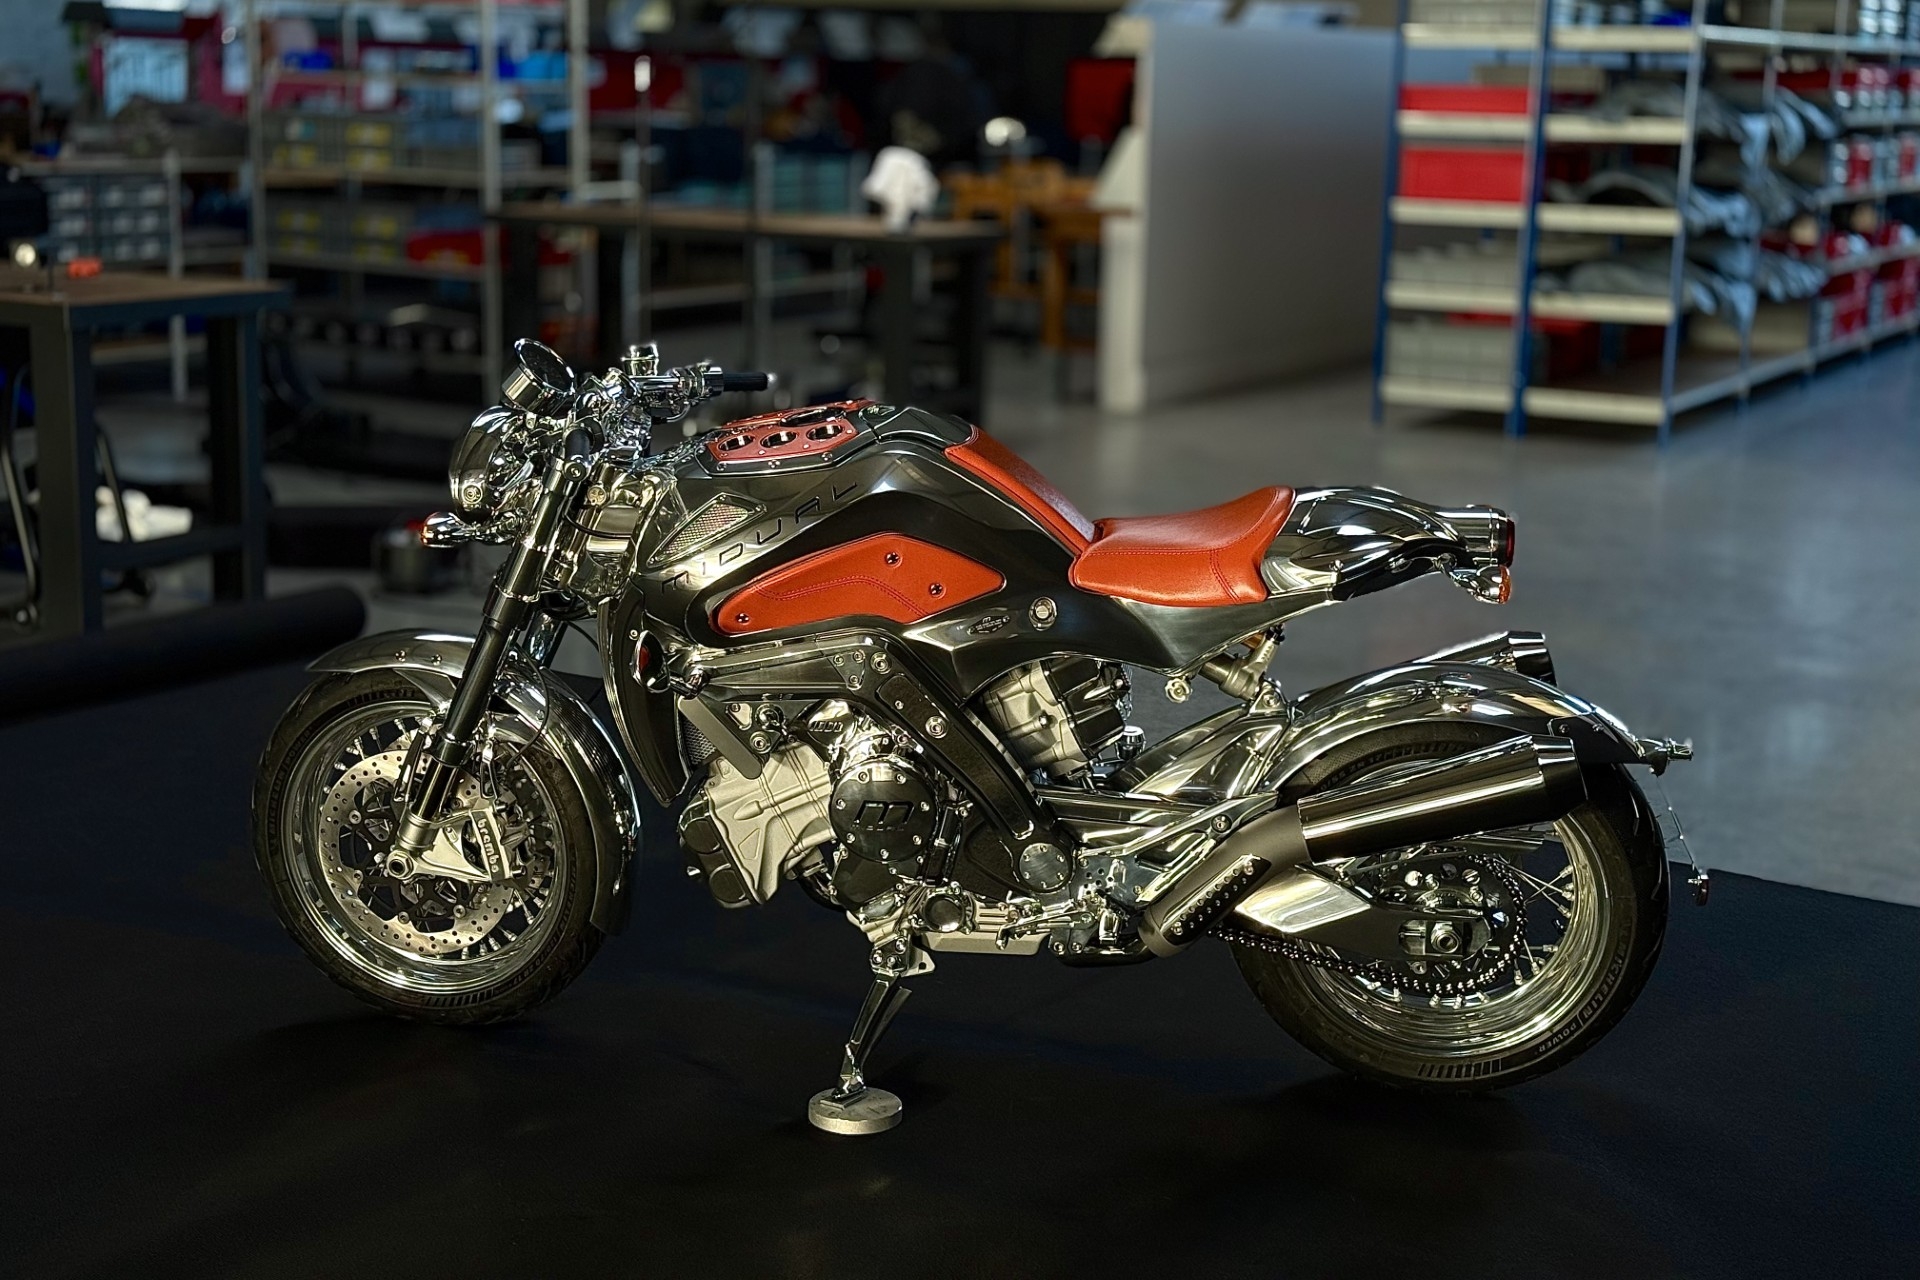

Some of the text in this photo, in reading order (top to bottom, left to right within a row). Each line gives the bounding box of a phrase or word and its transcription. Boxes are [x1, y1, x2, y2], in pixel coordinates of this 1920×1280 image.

[477, 818, 500, 873] brembo
[1537, 941, 1628, 1052] MICHELIN POWER
